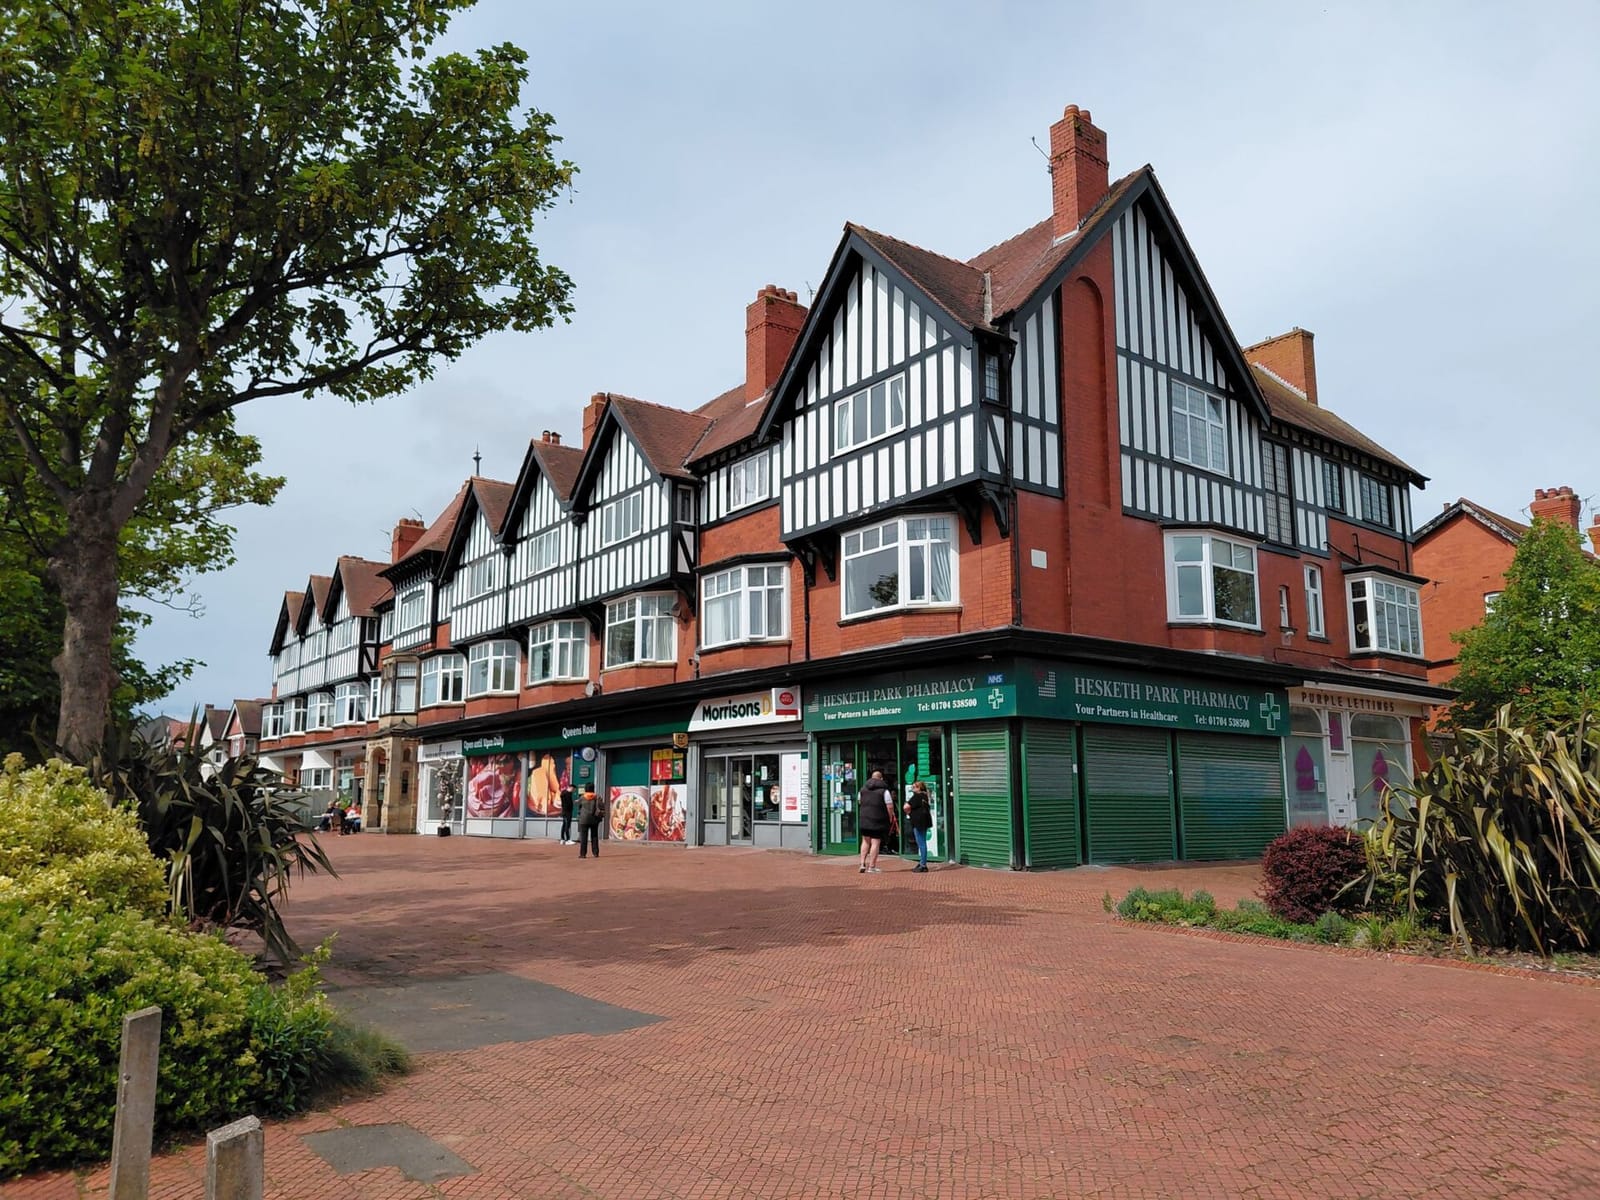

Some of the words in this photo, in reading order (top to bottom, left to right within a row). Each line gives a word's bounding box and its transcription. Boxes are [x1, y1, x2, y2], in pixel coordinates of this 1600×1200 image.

[988, 674, 1003, 684] NHS
[823, 690, 870, 707] HESKETH
[873, 687, 903, 702] PARK
[906, 677, 976, 699] PHARMACY
[1074, 677, 1141, 700] HESKETH
[1145, 685, 1179, 704] PARK
[1183, 688, 1250, 711] PHARMACY
[702, 699, 761, 722] Morrisons
[917, 703, 930, 712] Tel:
[931, 701, 951, 710] 01704
[952, 698, 977, 708] 538500
[1301, 692, 1343, 707] PURPLE
[1347, 697, 1394, 712] LETTINGS
[823, 711, 837, 720] Your
[837, 709, 861, 719] Partners
[862, 709, 869, 717] in
[869, 706, 901, 716] Healthcare
[1075, 703, 1095, 715] Your
[1096, 705, 1129, 718] Partners
[1130, 708, 1139, 719] in
[1140, 709, 1178, 722] Healthcare
[1194, 714, 1208, 725] Tel:
[1208, 716, 1227, 727] 01704
[1228, 718, 1250, 728] 538500
[562, 726, 582, 739] Queens
[582, 722, 597, 735] Road
